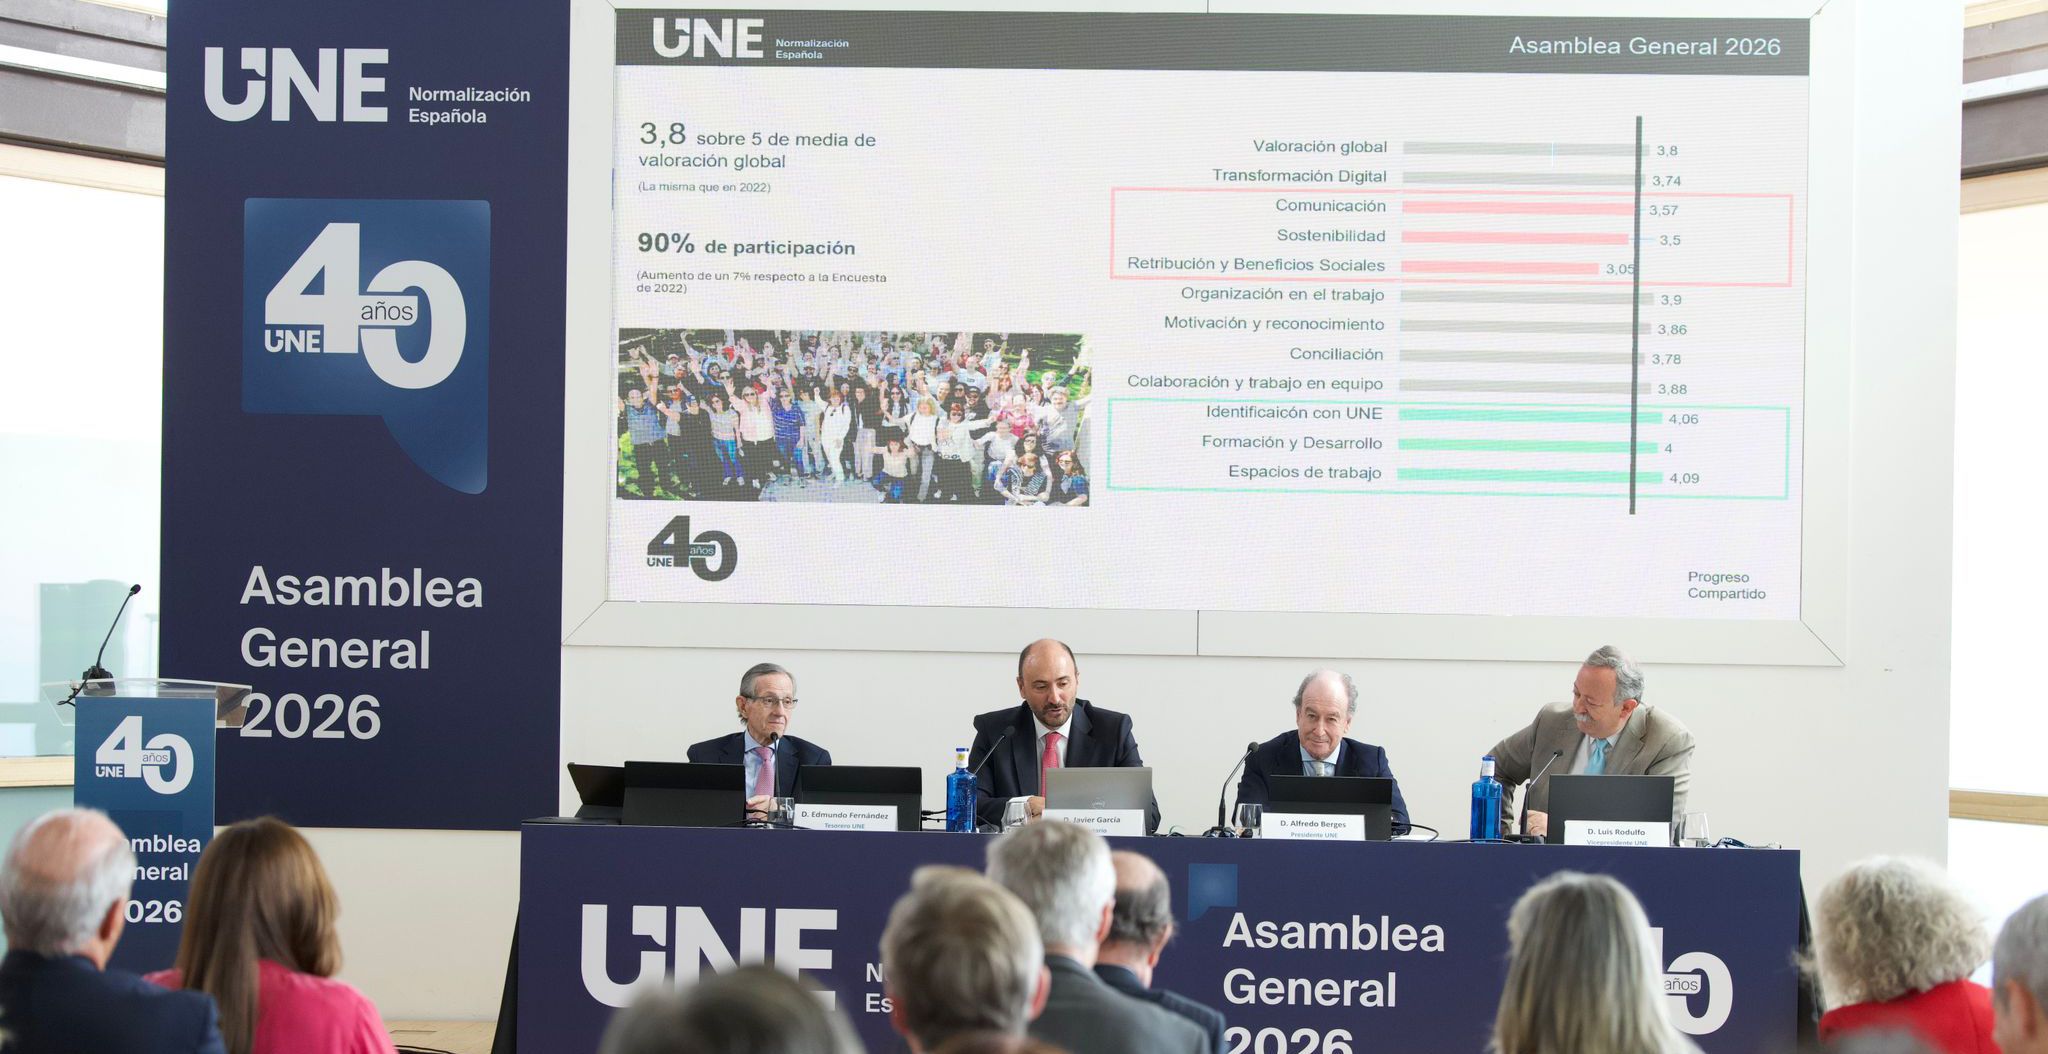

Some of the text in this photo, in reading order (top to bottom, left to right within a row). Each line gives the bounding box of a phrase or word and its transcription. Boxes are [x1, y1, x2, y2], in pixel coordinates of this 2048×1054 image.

[652, 17, 764, 58] UNE
[776, 38, 849, 48] Normalización
[1509, 36, 1781, 56] Asamblea General 2026
[776, 50, 823, 60] Española
[204, 46, 389, 122] UNE
[409, 86, 531, 103] Normalización
[409, 108, 487, 125] Española
[640, 122, 876, 147] 3,8 sobre 5 de media de
[1253, 139, 1387, 156] Valoración global
[1657, 145, 1678, 158] 3,8
[639, 154, 786, 171] valoración global
[1213, 169, 1387, 185] Transformación Digital
[1652, 175, 1681, 188] 3,74
[638, 181, 771, 193] (La misma que en 2022)
[1276, 199, 1386, 212] Comunicación
[1649, 205, 1678, 218] 3,57
[1277, 229, 1386, 242] Sostenibilidad
[1660, 234, 1681, 247] 3,5
[638, 232, 855, 257] 90% de participación
[1128, 257, 1385, 273] Retribución y Beneficios Sociales
[1606, 263, 1635, 276] 3,05
[637, 271, 887, 283] (Aumento de un 7% respecto a la Encuesta
[637, 284, 687, 294] de 2022)
[1181, 286, 1384, 304] Organización en el trabajo
[264, 223, 467, 390] 40
[1661, 294, 1682, 307] 3,9
[360, 302, 414, 322] años
[1164, 316, 1385, 332] Motivación y reconocimiento
[1658, 324, 1687, 337] 3,86
[264, 330, 321, 353] UNE
[1290, 347, 1384, 361] Conciliación
[1652, 354, 1681, 366] 3,78
[1128, 374, 1383, 392] Colaboración y trabajo en equipo
[1658, 384, 1688, 397] 3,88
[1207, 405, 1383, 419] Identificaicón con UNE
[1668, 413, 1698, 426] 4,06
[1202, 435, 1383, 452] Formación y Desarrollo
[1664, 444, 1672, 454] 4
[1229, 465, 1382, 481] Espacios de trabajo
[1669, 473, 1700, 485] 4,09
[647, 515, 738, 581] 40
[690, 546, 715, 555] años
[647, 558, 672, 567] UNE
[1688, 571, 1749, 585] Progreso
[240, 565, 483, 608] Asamblea
[1688, 588, 1766, 601] Compartido
[240, 627, 430, 670] General
[240, 693, 381, 740] 2026
[95, 715, 194, 794] 40
[142, 753, 168, 762] años
[95, 766, 123, 778] UNE
[129, 835, 200, 853] mblea
[132, 863, 188, 880] neral
[124, 900, 182, 923] 026
[1223, 912, 1445, 952] Asamblea
[581, 903, 838, 1012] UNE
[1223, 968, 1396, 1007] General
[1664, 978, 1698, 991] años
[1224, 1027, 1353, 1054] 2026
